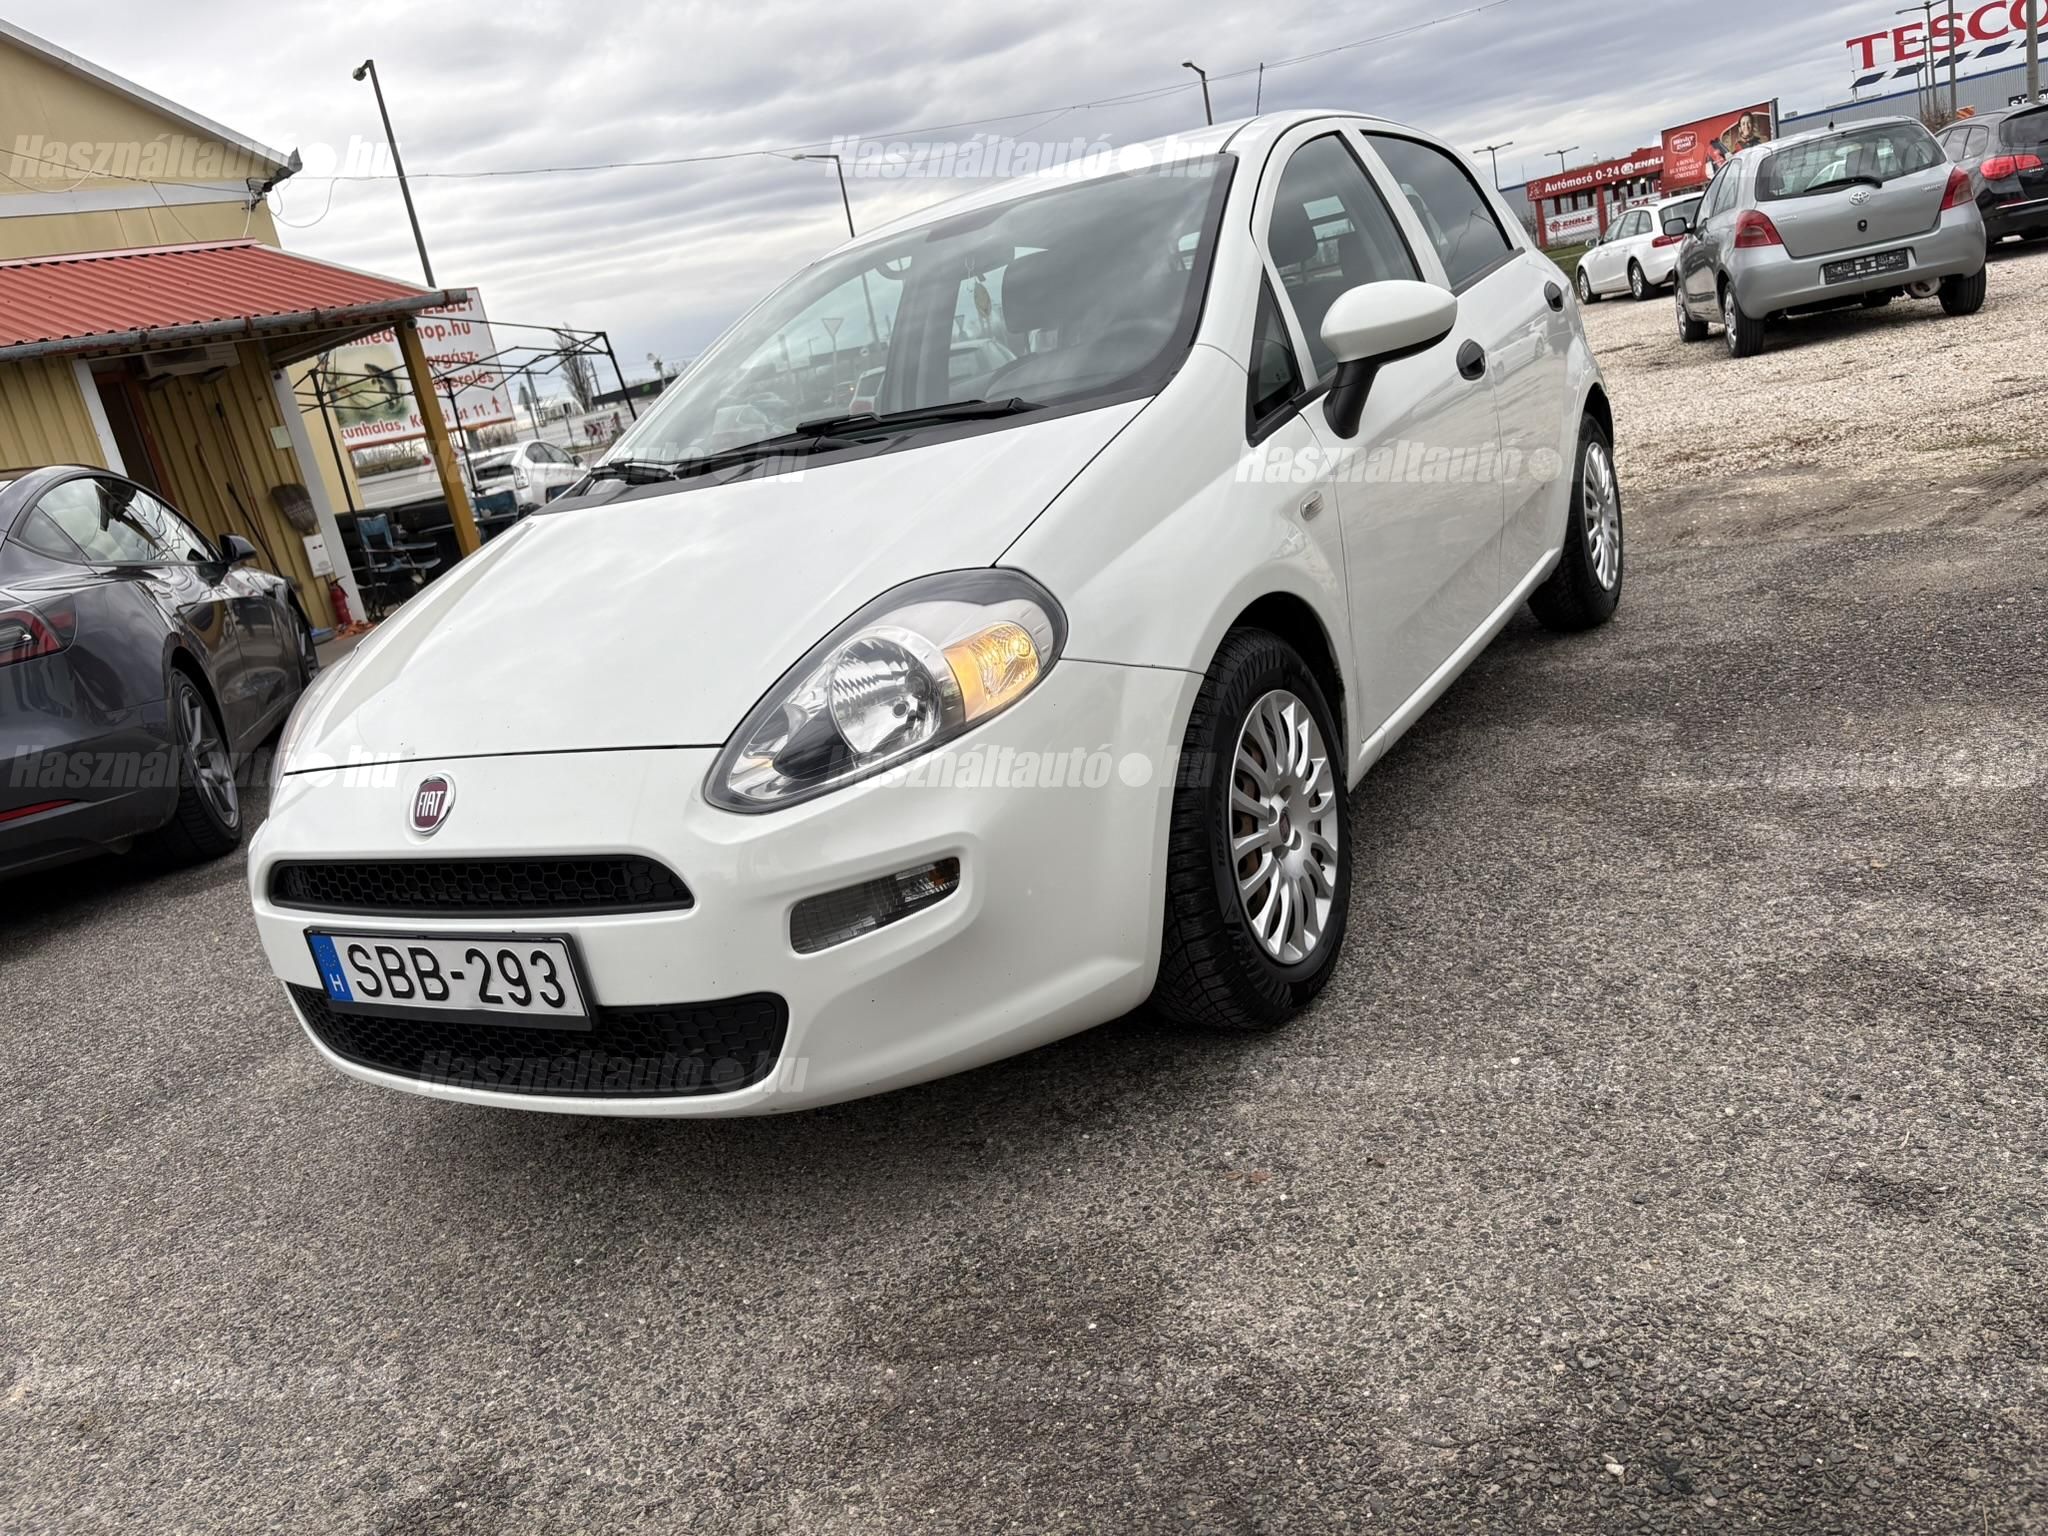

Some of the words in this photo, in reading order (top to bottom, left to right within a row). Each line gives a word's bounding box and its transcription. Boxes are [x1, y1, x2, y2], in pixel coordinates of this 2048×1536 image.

[1846, 0, 2048, 69] TESCO
[1544, 171, 1593, 193] Autómosó
[1595, 165, 1619, 181] 0-24
[416, 788, 445, 817] FIAT
[331, 973, 345, 993] H
[347, 943, 566, 1008] SBB-293
